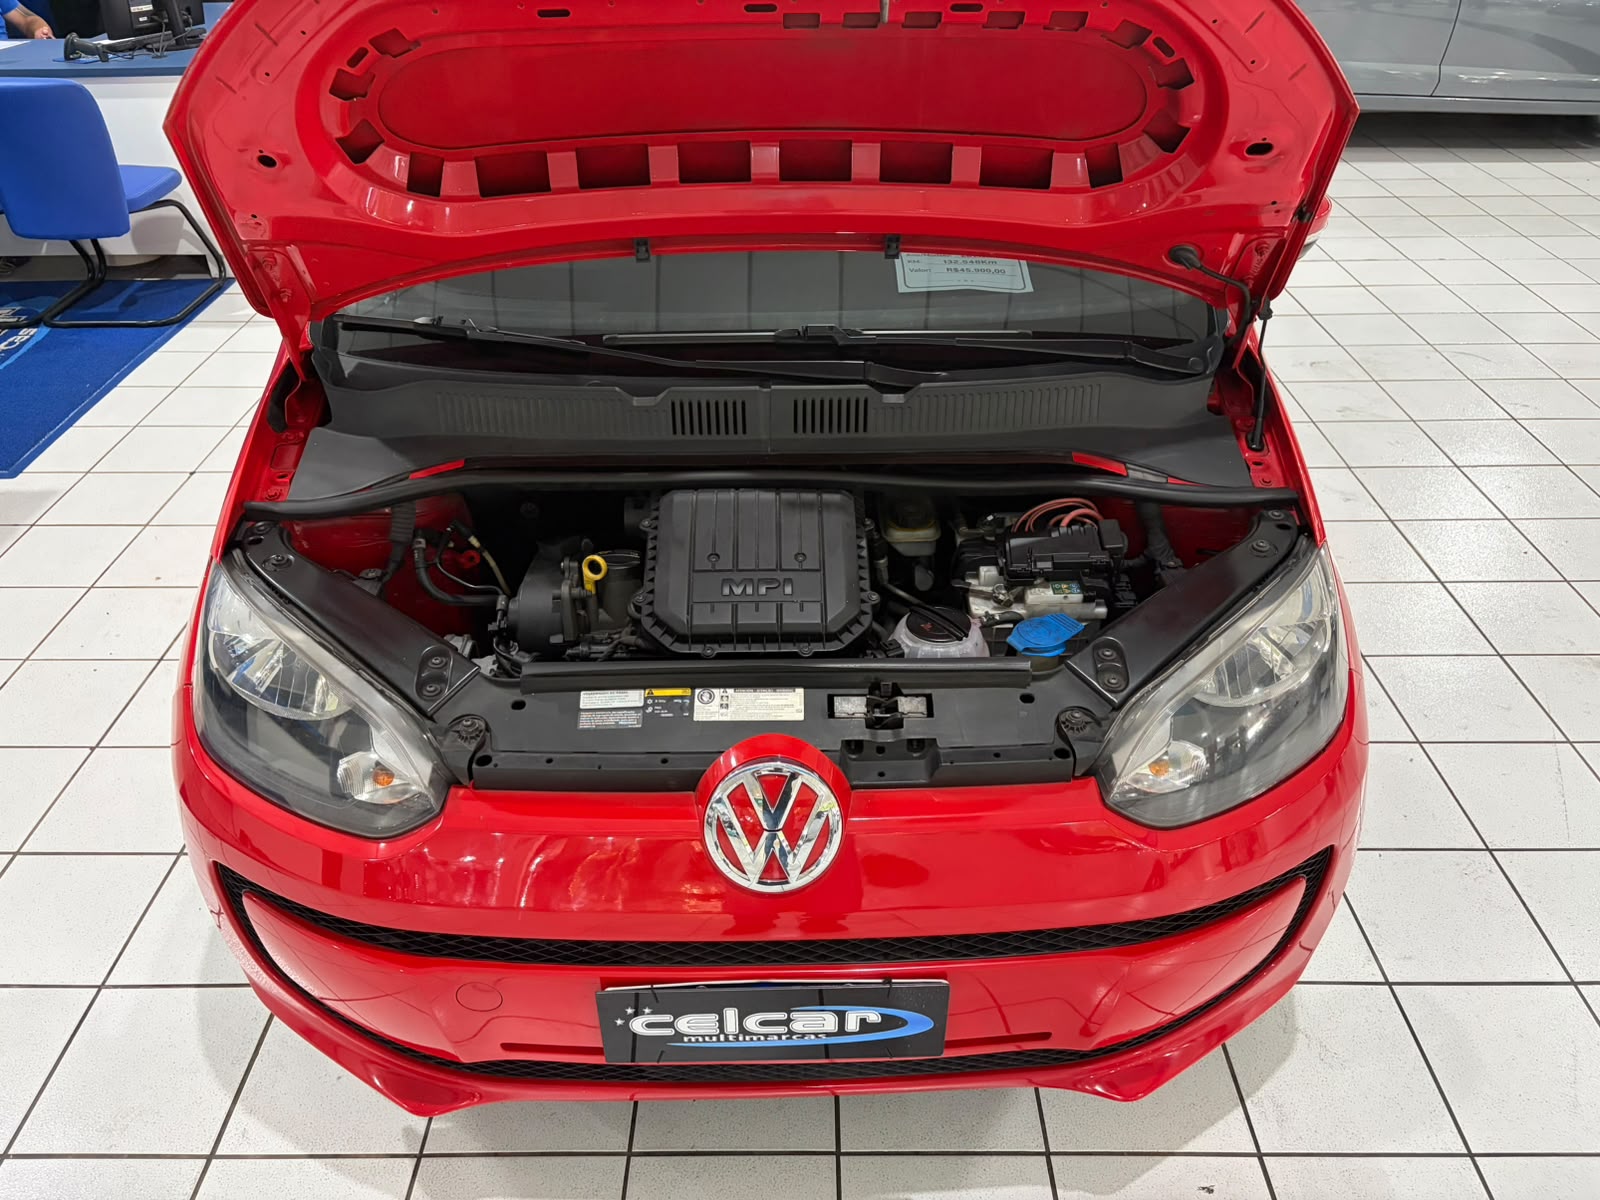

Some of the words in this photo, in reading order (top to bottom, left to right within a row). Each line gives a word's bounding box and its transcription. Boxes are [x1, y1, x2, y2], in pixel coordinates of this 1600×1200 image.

[721, 577, 793, 596] MPI
[629, 1007, 881, 1036] celcar
[683, 1033, 827, 1042] multimarcas
